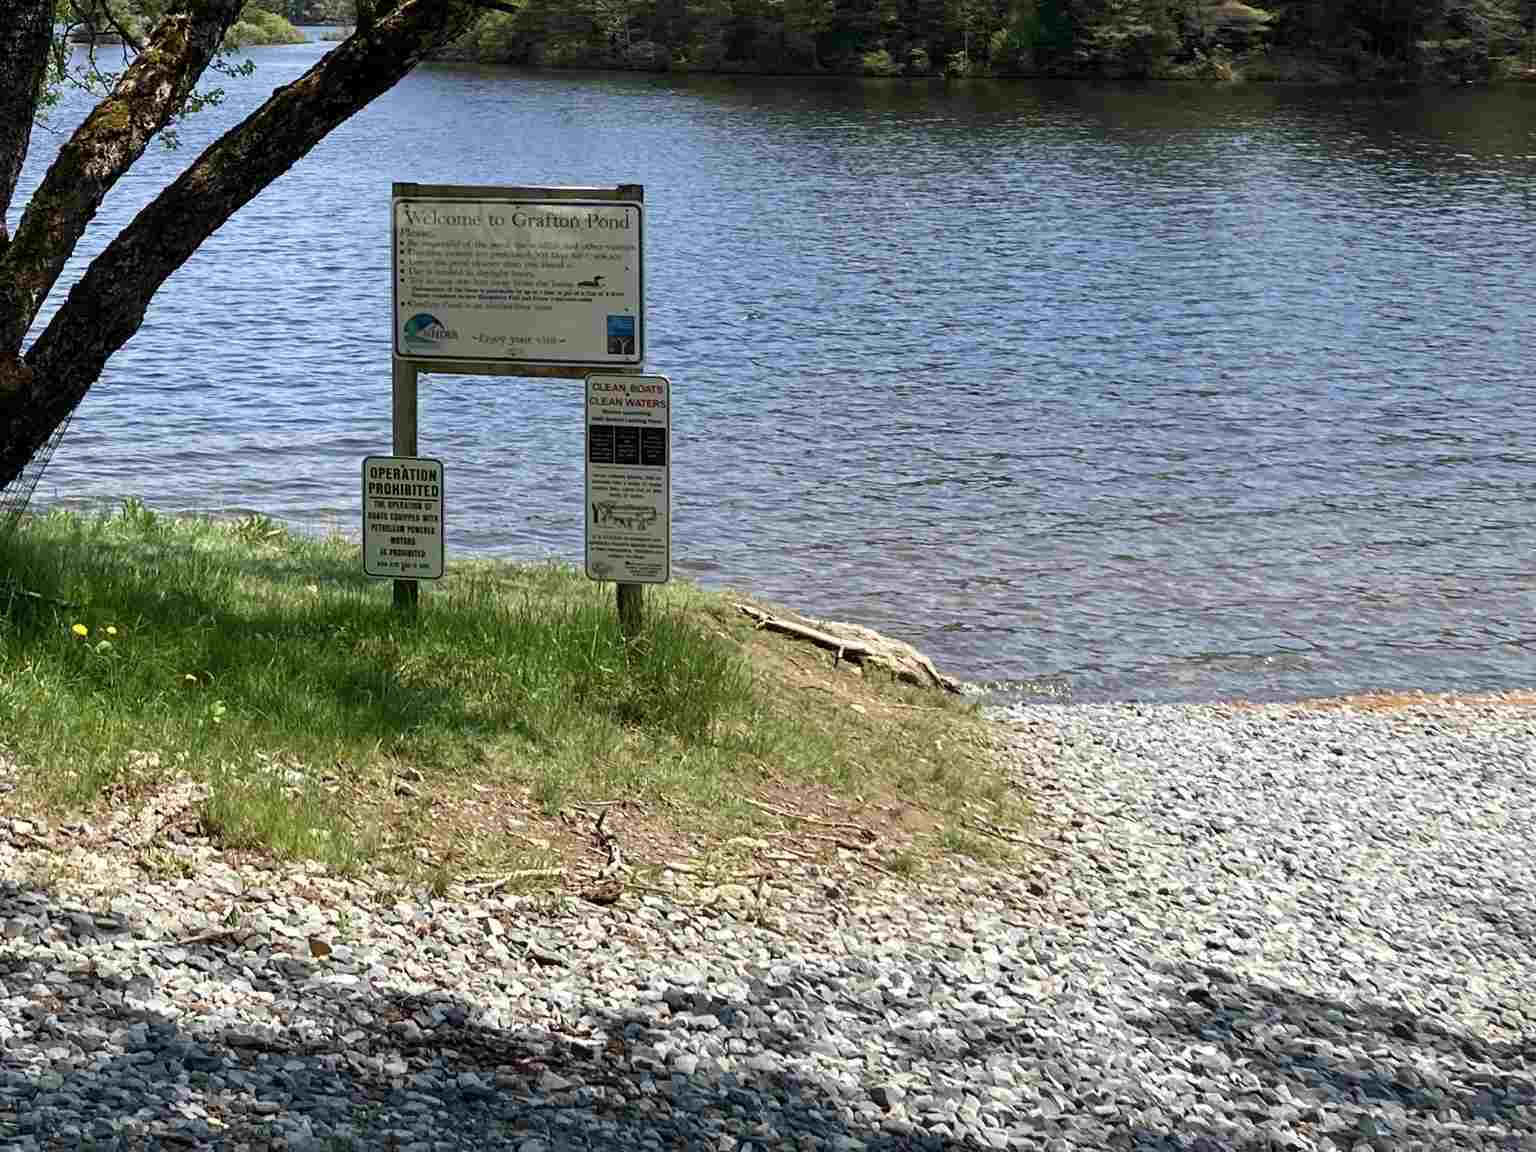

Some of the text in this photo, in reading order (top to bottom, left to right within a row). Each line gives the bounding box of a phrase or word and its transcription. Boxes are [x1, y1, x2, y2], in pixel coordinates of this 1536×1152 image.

[405, 209, 629, 230] Welcome to Grafton Pond
[592, 383, 625, 393] CLEAN
[590, 397, 666, 409] CLEAN WATERS
[370, 467, 437, 482] OPERATION
[368, 482, 439, 497] PROHIBITED
